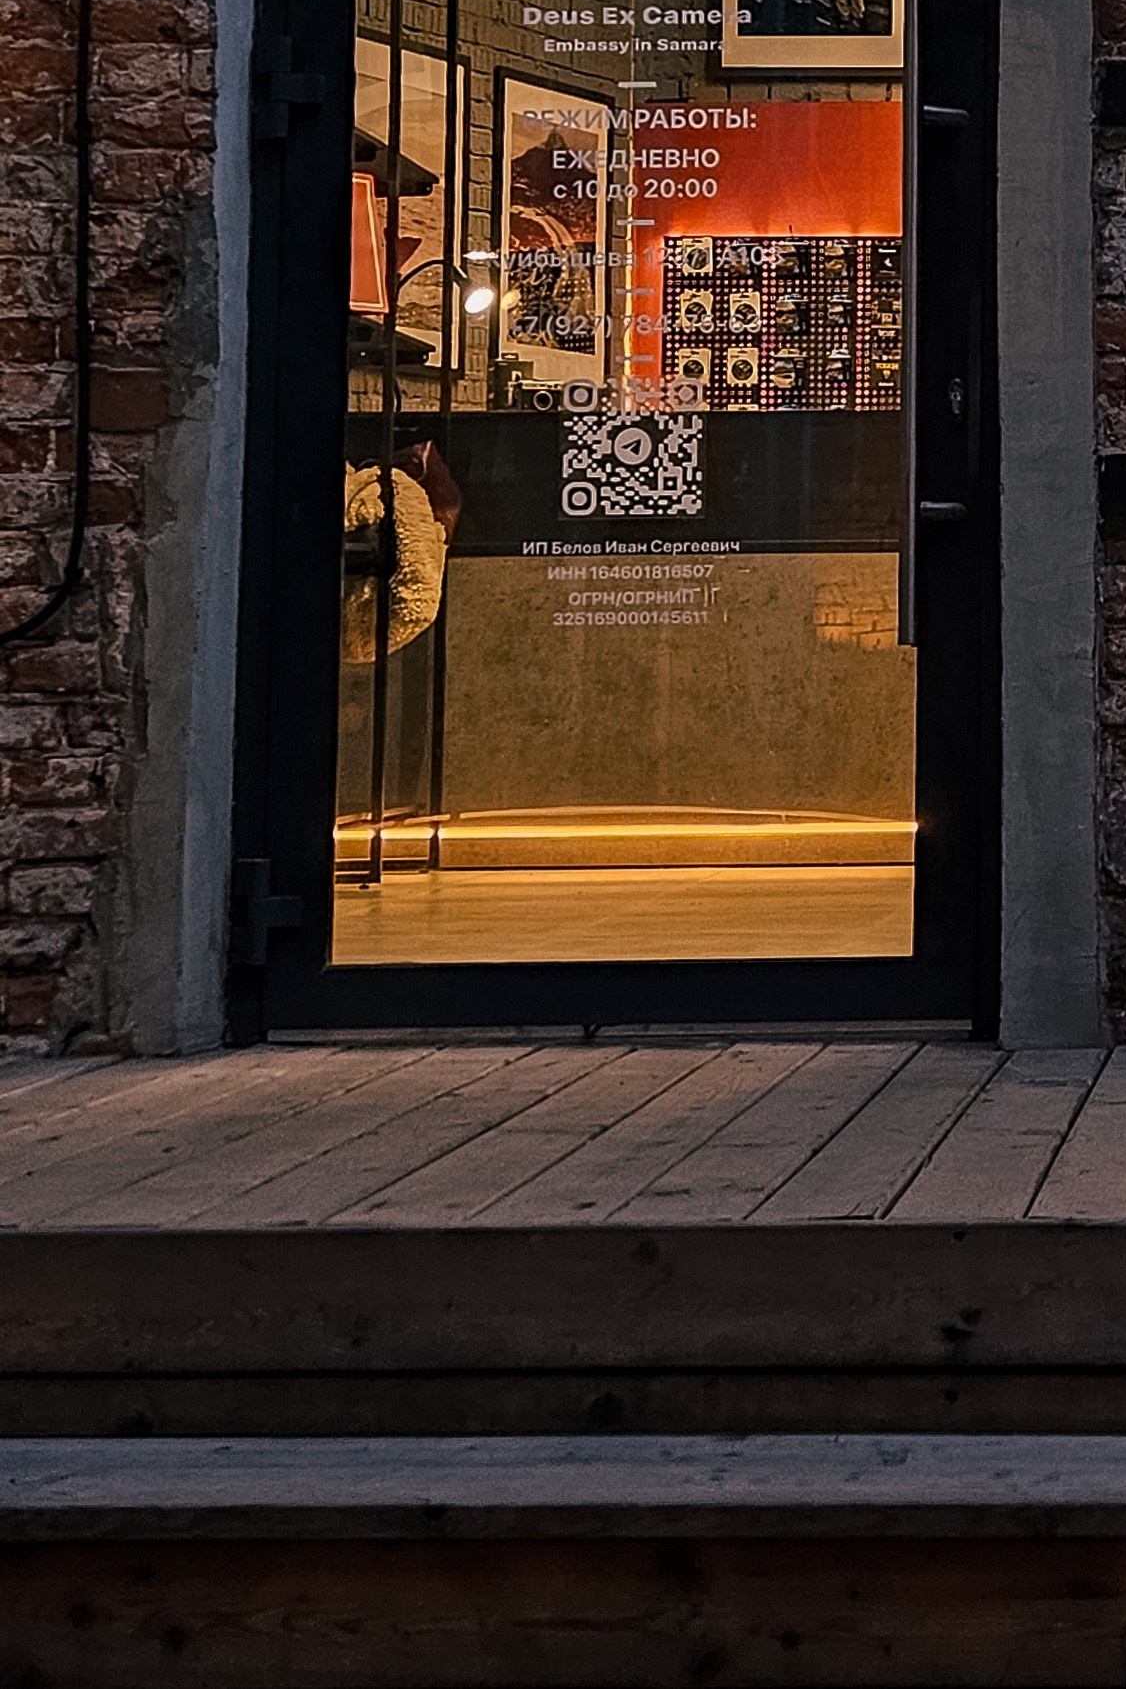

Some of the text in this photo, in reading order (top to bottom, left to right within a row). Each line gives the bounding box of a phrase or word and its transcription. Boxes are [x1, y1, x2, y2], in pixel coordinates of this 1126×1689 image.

[523, 7, 595, 25] Deus
[602, 7, 635, 25] Ex
[543, 39, 630, 55] Embassy
[634, 38, 652, 51] in
[523, 108, 757, 129] РЕЖИМ РАБОТЫ:
[552, 148, 720, 172] ЕЖЕДНЕВНО
[572, 180, 602, 199] 10
[606, 183, 638, 202] до
[643, 179, 718, 199] 20:00
[522, 540, 740, 556] ИП Белов Иван Сергеевич
[547, 566, 587, 580] ИНН
